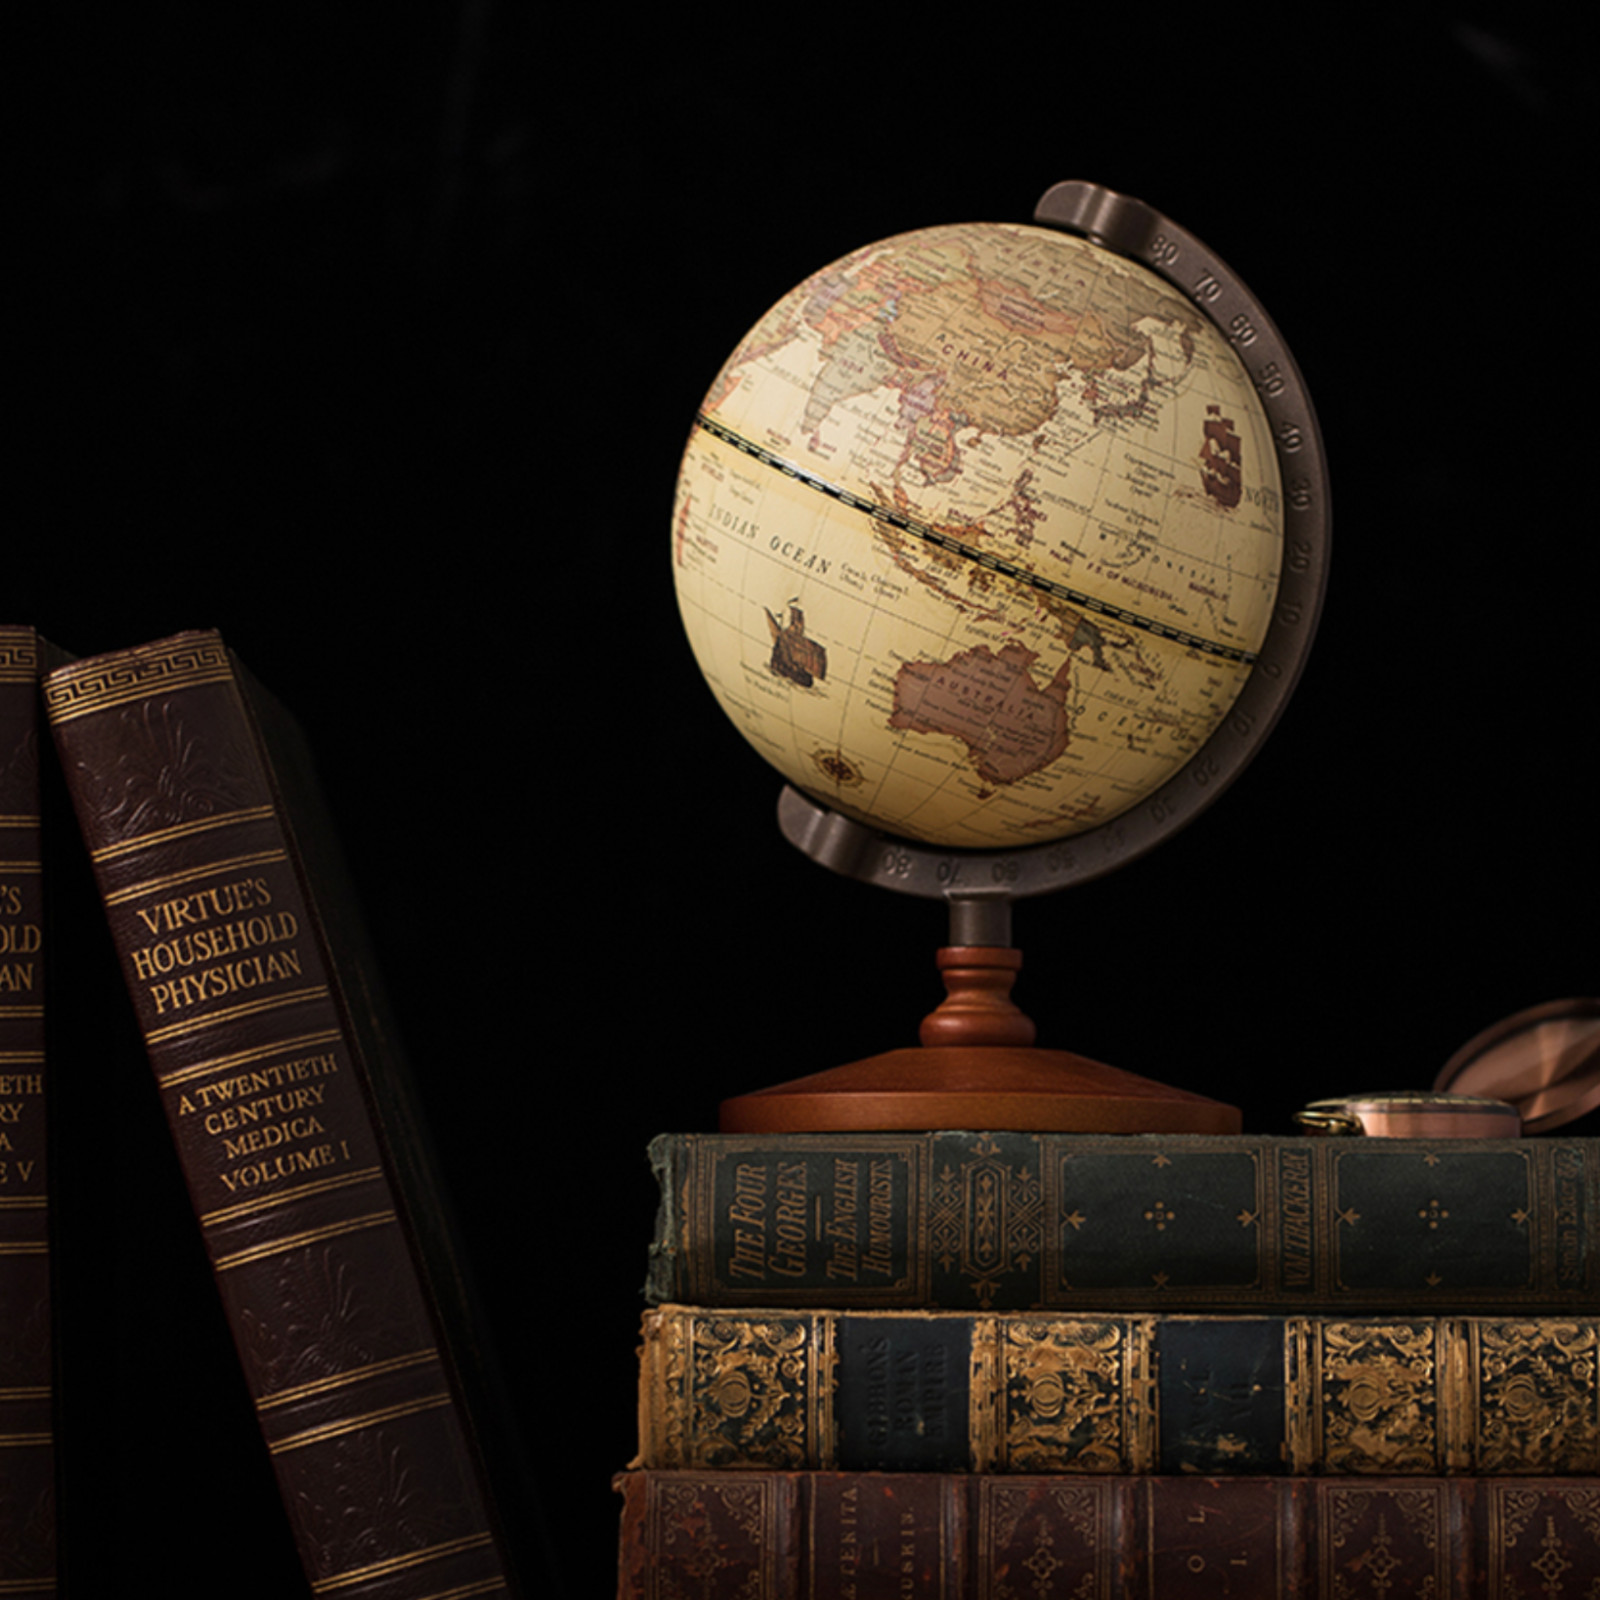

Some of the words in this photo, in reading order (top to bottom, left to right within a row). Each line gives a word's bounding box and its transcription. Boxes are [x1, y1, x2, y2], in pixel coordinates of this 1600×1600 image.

[1152, 234, 1180, 267] 80
[1195, 268, 1223, 302] 70
[1229, 312, 1258, 347] 60
[942, 343, 1008, 381] CHINA
[1260, 361, 1285, 398] 50
[1279, 421, 1303, 454] 40
[1291, 478, 1312, 511] 30
[708, 502, 760, 540] INDIAN
[768, 534, 832, 575] OCEAN
[1289, 541, 1313, 574] 20
[1264, 661, 1282, 679] 0
[935, 676, 1034, 721] AUSTRALIA
[883, 853, 912, 880] 80
[0, 885, 22, 916] 'S
[136, 877, 272, 936] VIRTUE'S
[131, 911, 299, 981] HOUSEHOLD
[150, 948, 302, 1014] PHYSICIAN
[178, 1095, 197, 1117] A
[195, 1053, 339, 1108] TWENTIETH
[205, 1083, 326, 1136] CENTURY
[222, 1116, 325, 1160] MEDICA
[16, 1160, 36, 1183] V
[220, 1143, 337, 1193] VOLUME
[341, 1140, 351, 1161] I
[728, 1162, 768, 1230] FOUR
[767, 1160, 808, 1278] GEORGES.
[825, 1157, 859, 1243] ENGLISH
[729, 1228, 766, 1281] THE
[825, 1241, 858, 1282] THE
[1557, 1229, 1580, 1282] Smith
[858, 1335, 890, 1447] GIBBON'S
[896, 1352, 919, 1430] ROMAN
[922, 1344, 947, 1438] EMPIRE
